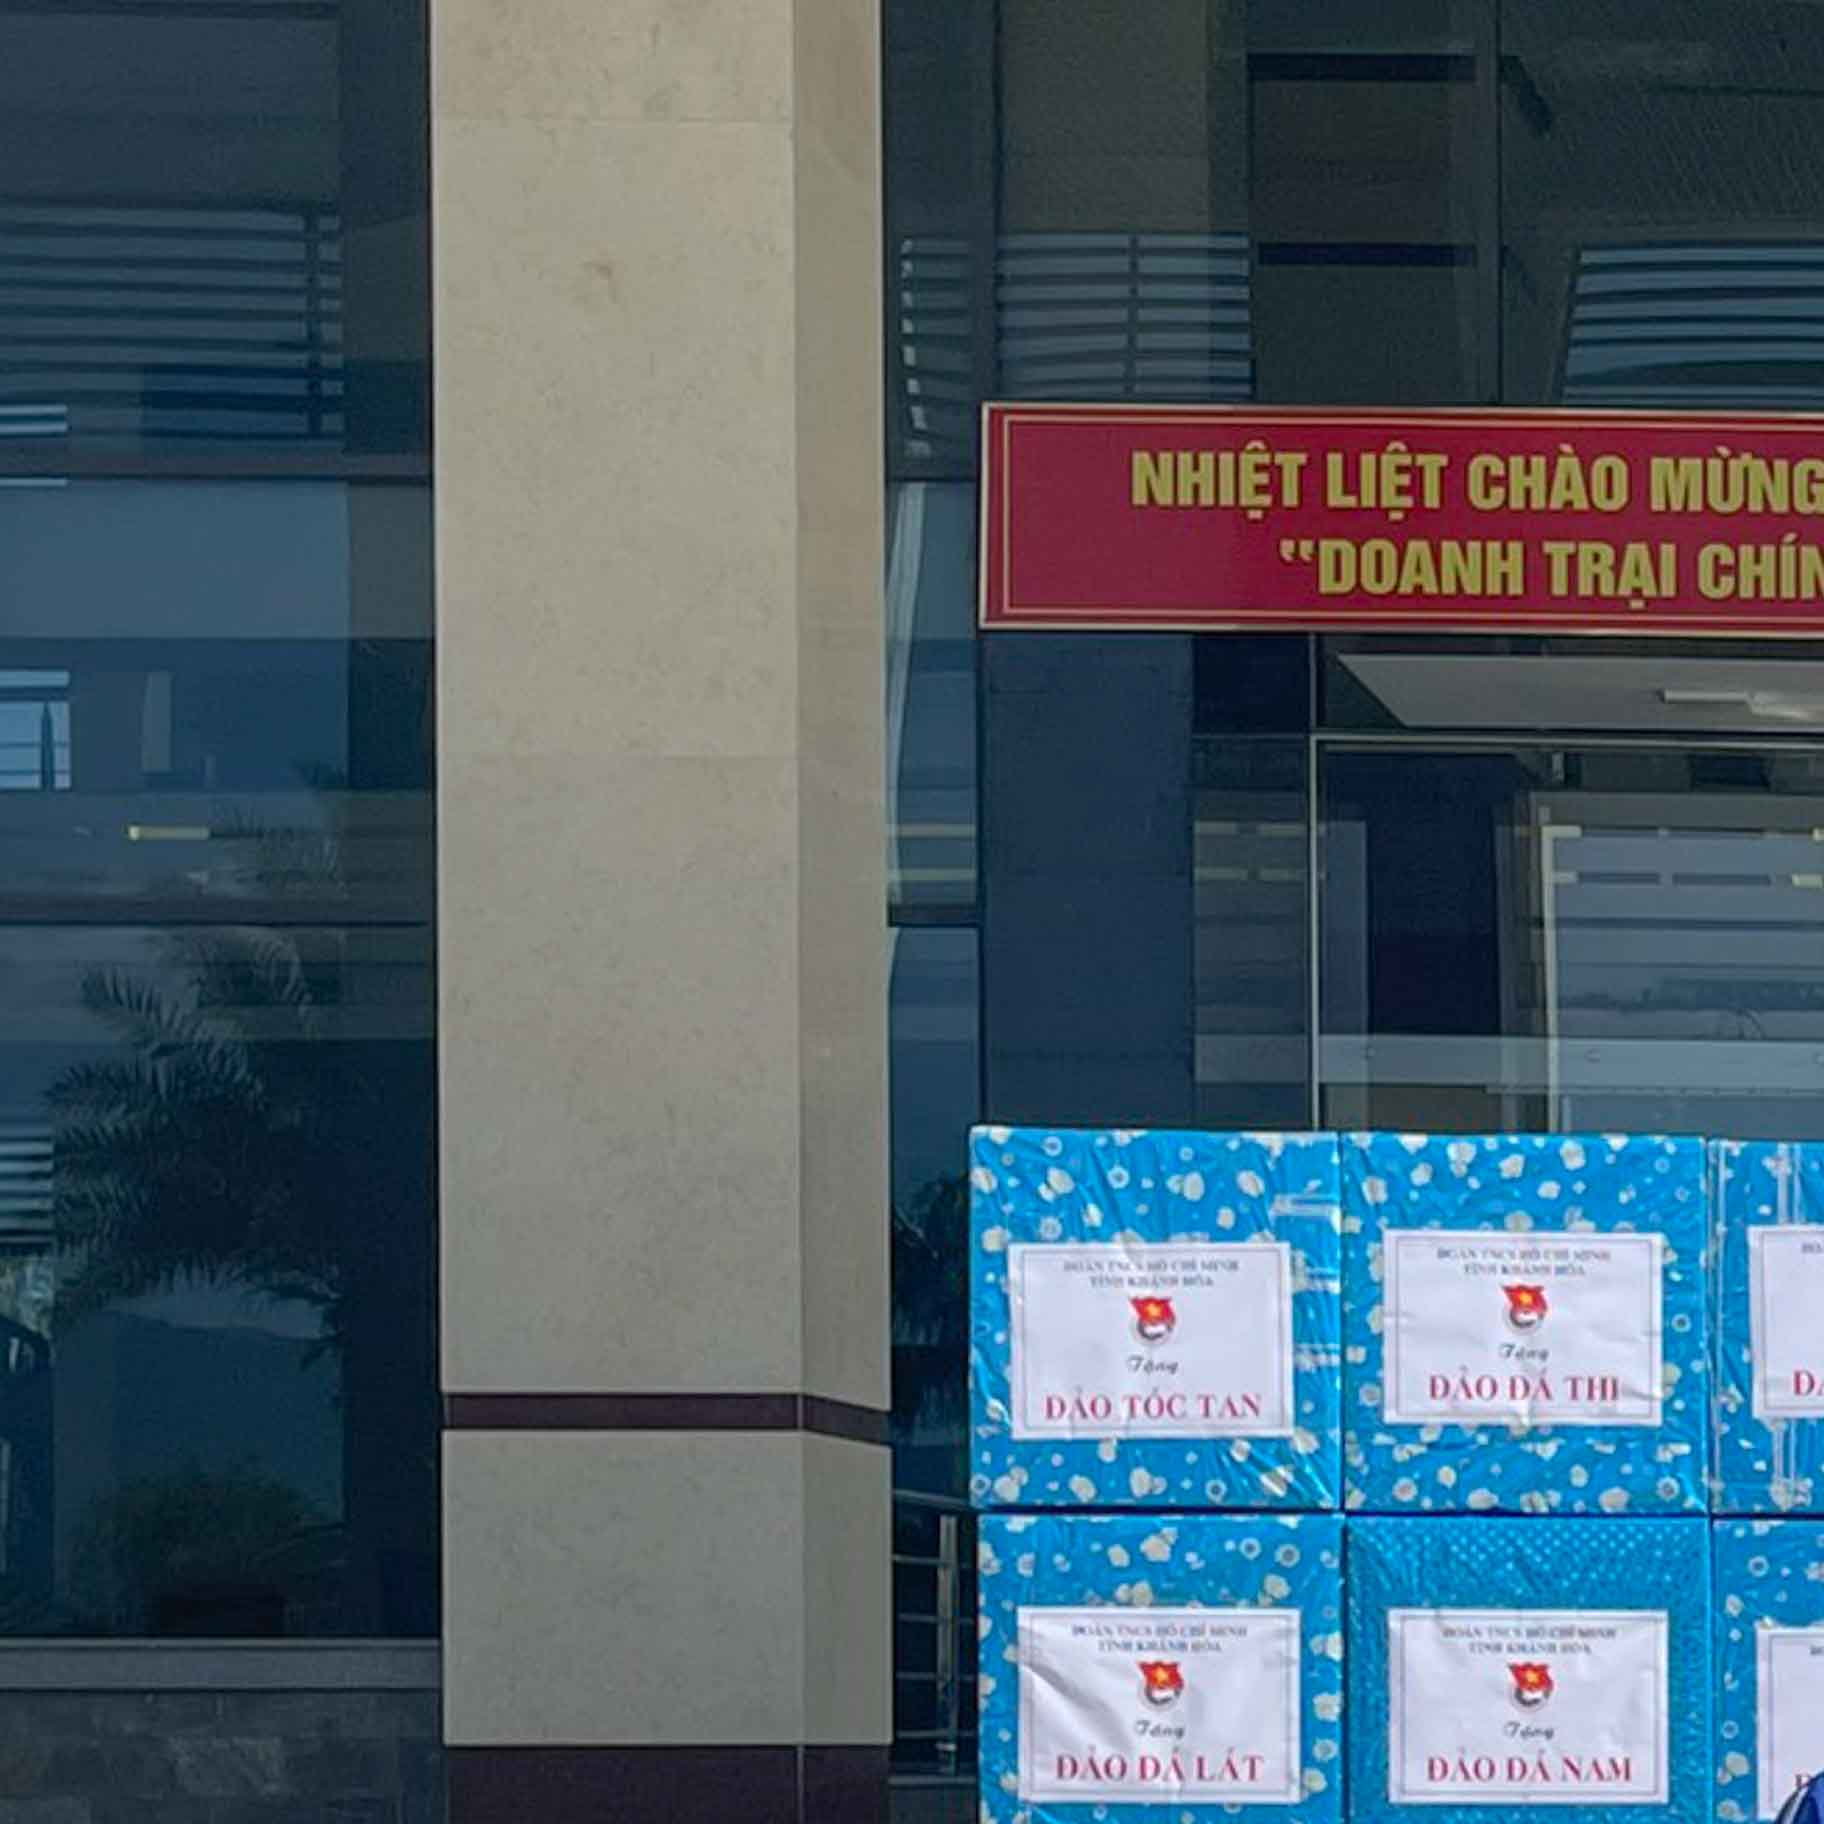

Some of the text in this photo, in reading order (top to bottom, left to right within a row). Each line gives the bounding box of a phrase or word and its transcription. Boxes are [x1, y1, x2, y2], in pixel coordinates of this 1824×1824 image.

[1131, 441, 1306, 520] NHIỆT
[1326, 441, 1451, 522] LIỆT
[1468, 449, 1627, 512] CHÀO
[1544, 543, 1677, 612] TRẠI
